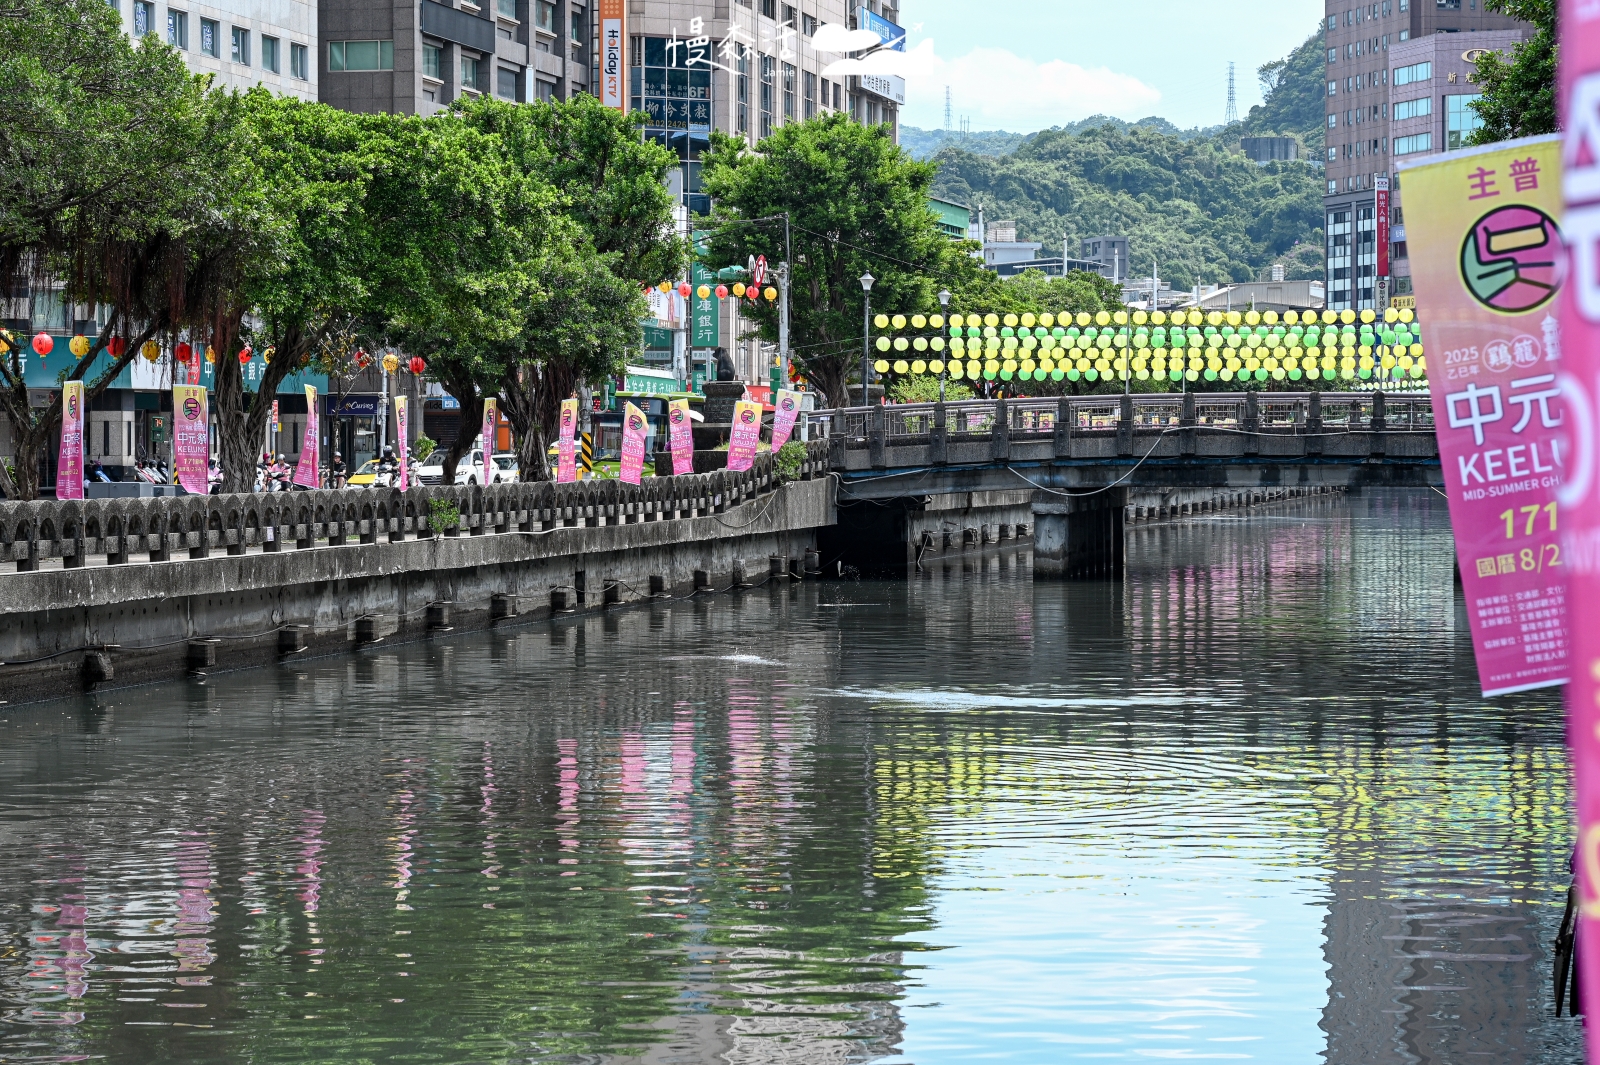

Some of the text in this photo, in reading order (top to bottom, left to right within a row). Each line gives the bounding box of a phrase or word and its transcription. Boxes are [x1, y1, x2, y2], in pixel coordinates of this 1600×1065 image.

[604, 28, 619, 98] Holiday KTV
[689, 86, 704, 98] 6F
[1468, 157, 1541, 200] 主普
[1444, 346, 1479, 365] 2025
[1447, 364, 1480, 379] 乙巳年
[1445, 374, 1562, 446] 中元
[178, 432, 206, 445] 中元祭
[1463, 479, 1540, 501] MID-SUMMER
[1500, 501, 1557, 539] 171
